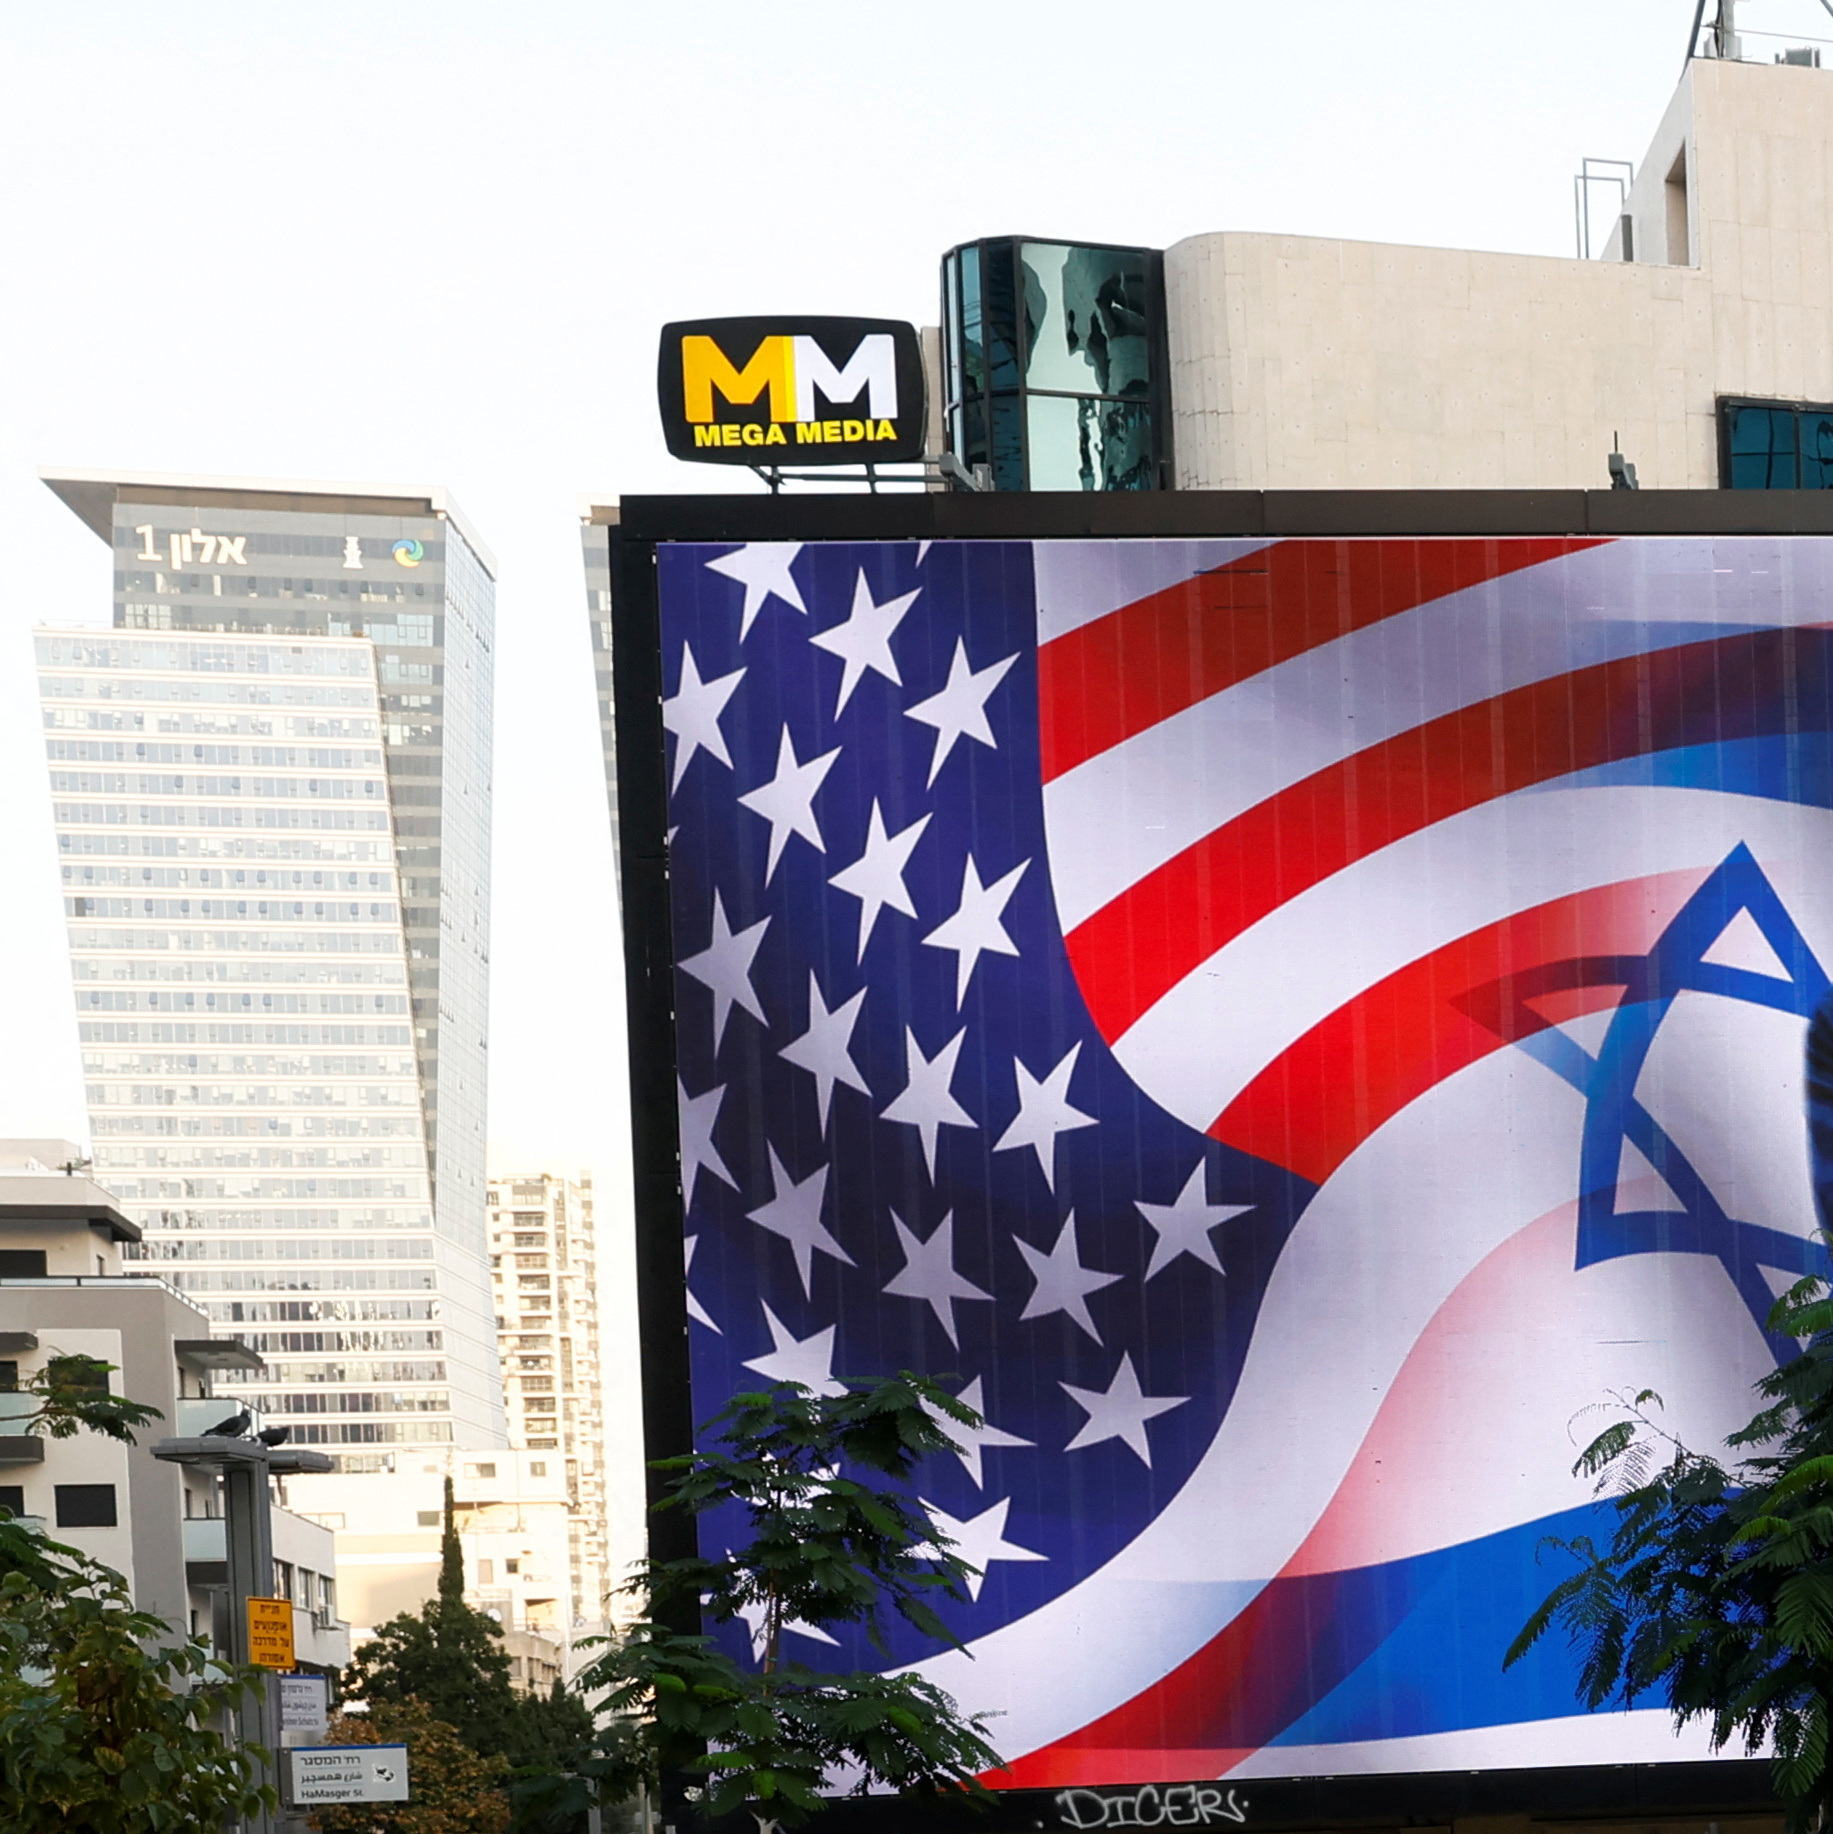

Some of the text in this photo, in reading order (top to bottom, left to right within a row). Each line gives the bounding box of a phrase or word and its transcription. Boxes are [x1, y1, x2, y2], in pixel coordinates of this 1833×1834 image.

[682, 334, 898, 423] MM
[694, 419, 898, 447] MEGA MEDIA
[135, 524, 248, 570] אלון 1
[300, 1756, 341, 1766] המסגר
[301, 1789, 351, 1799] HaMasger
